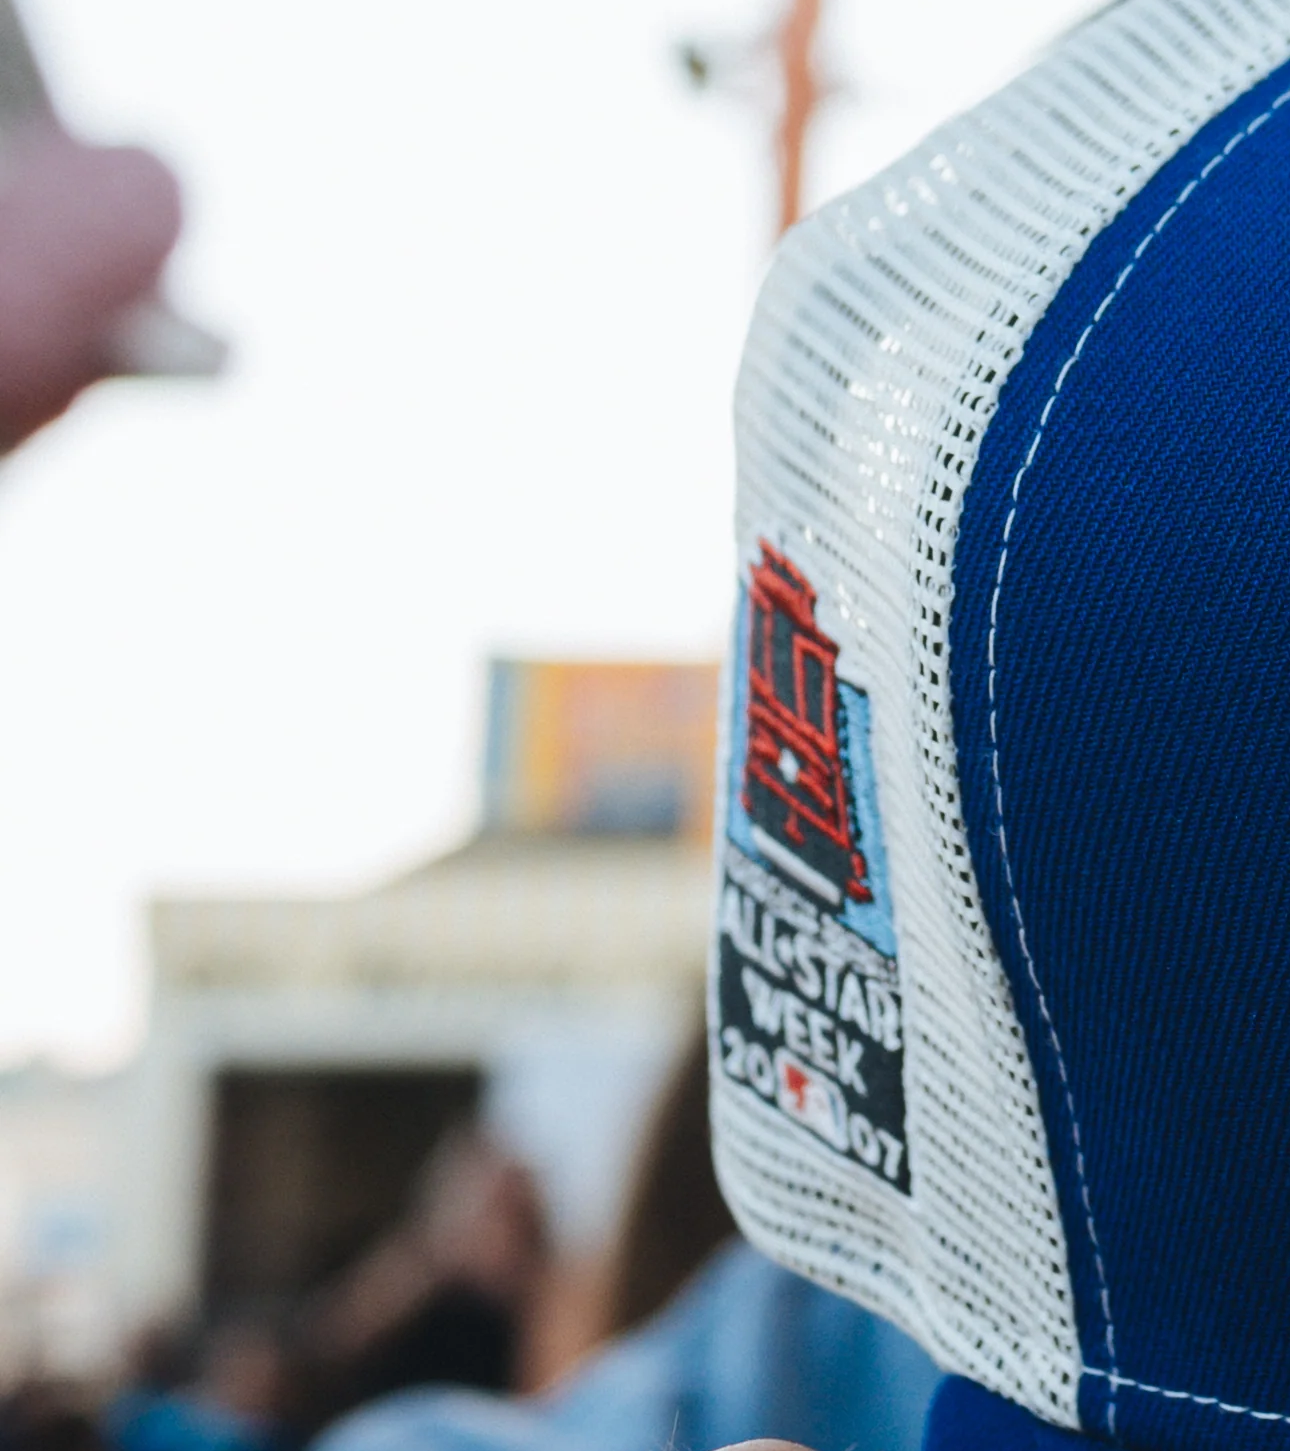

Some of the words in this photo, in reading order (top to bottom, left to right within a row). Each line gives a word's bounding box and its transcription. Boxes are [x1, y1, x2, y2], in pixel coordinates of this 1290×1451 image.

[722, 1026, 774, 1098] 20
[848, 1111, 903, 1180] 07
[741, 966, 868, 1098] WEEK
